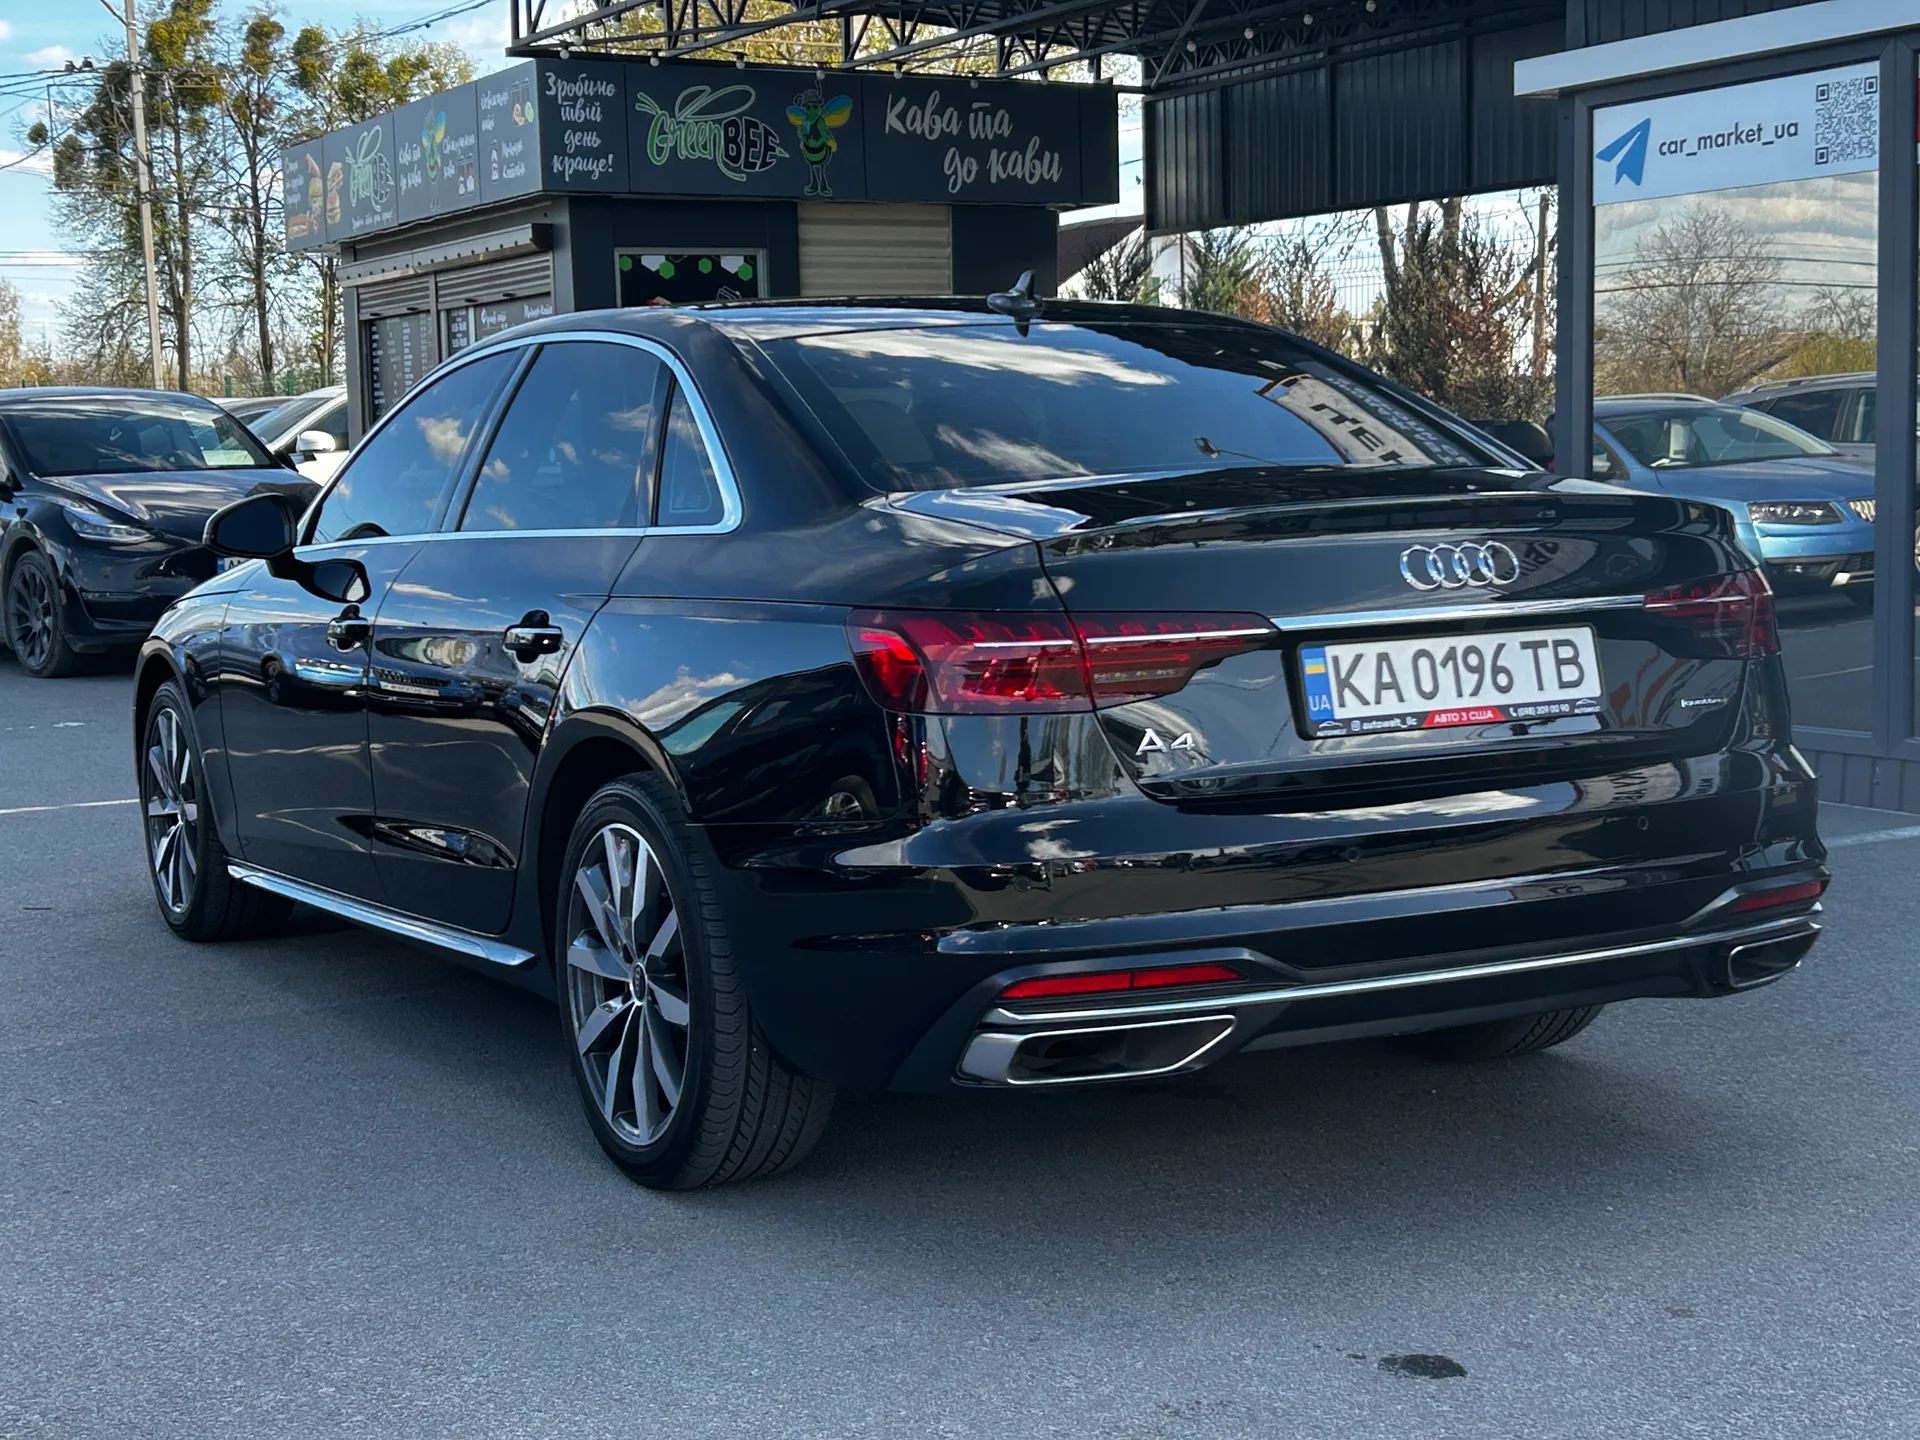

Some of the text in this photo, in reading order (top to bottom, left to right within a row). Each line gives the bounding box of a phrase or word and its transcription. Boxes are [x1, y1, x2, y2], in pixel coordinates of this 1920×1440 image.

[545, 72, 616, 104] Зробимо
[560, 101, 602, 123] твій
[885, 90, 1014, 140] Кава та
[564, 129, 601, 153] день
[1658, 121, 1799, 157] car_market_ua
[552, 154, 614, 182] краще!
[943, 136, 1063, 193] до кави
[1411, 642, 1514, 701] 0196
[1309, 695, 1332, 712] UA
[1135, 728, 1195, 756] A4
